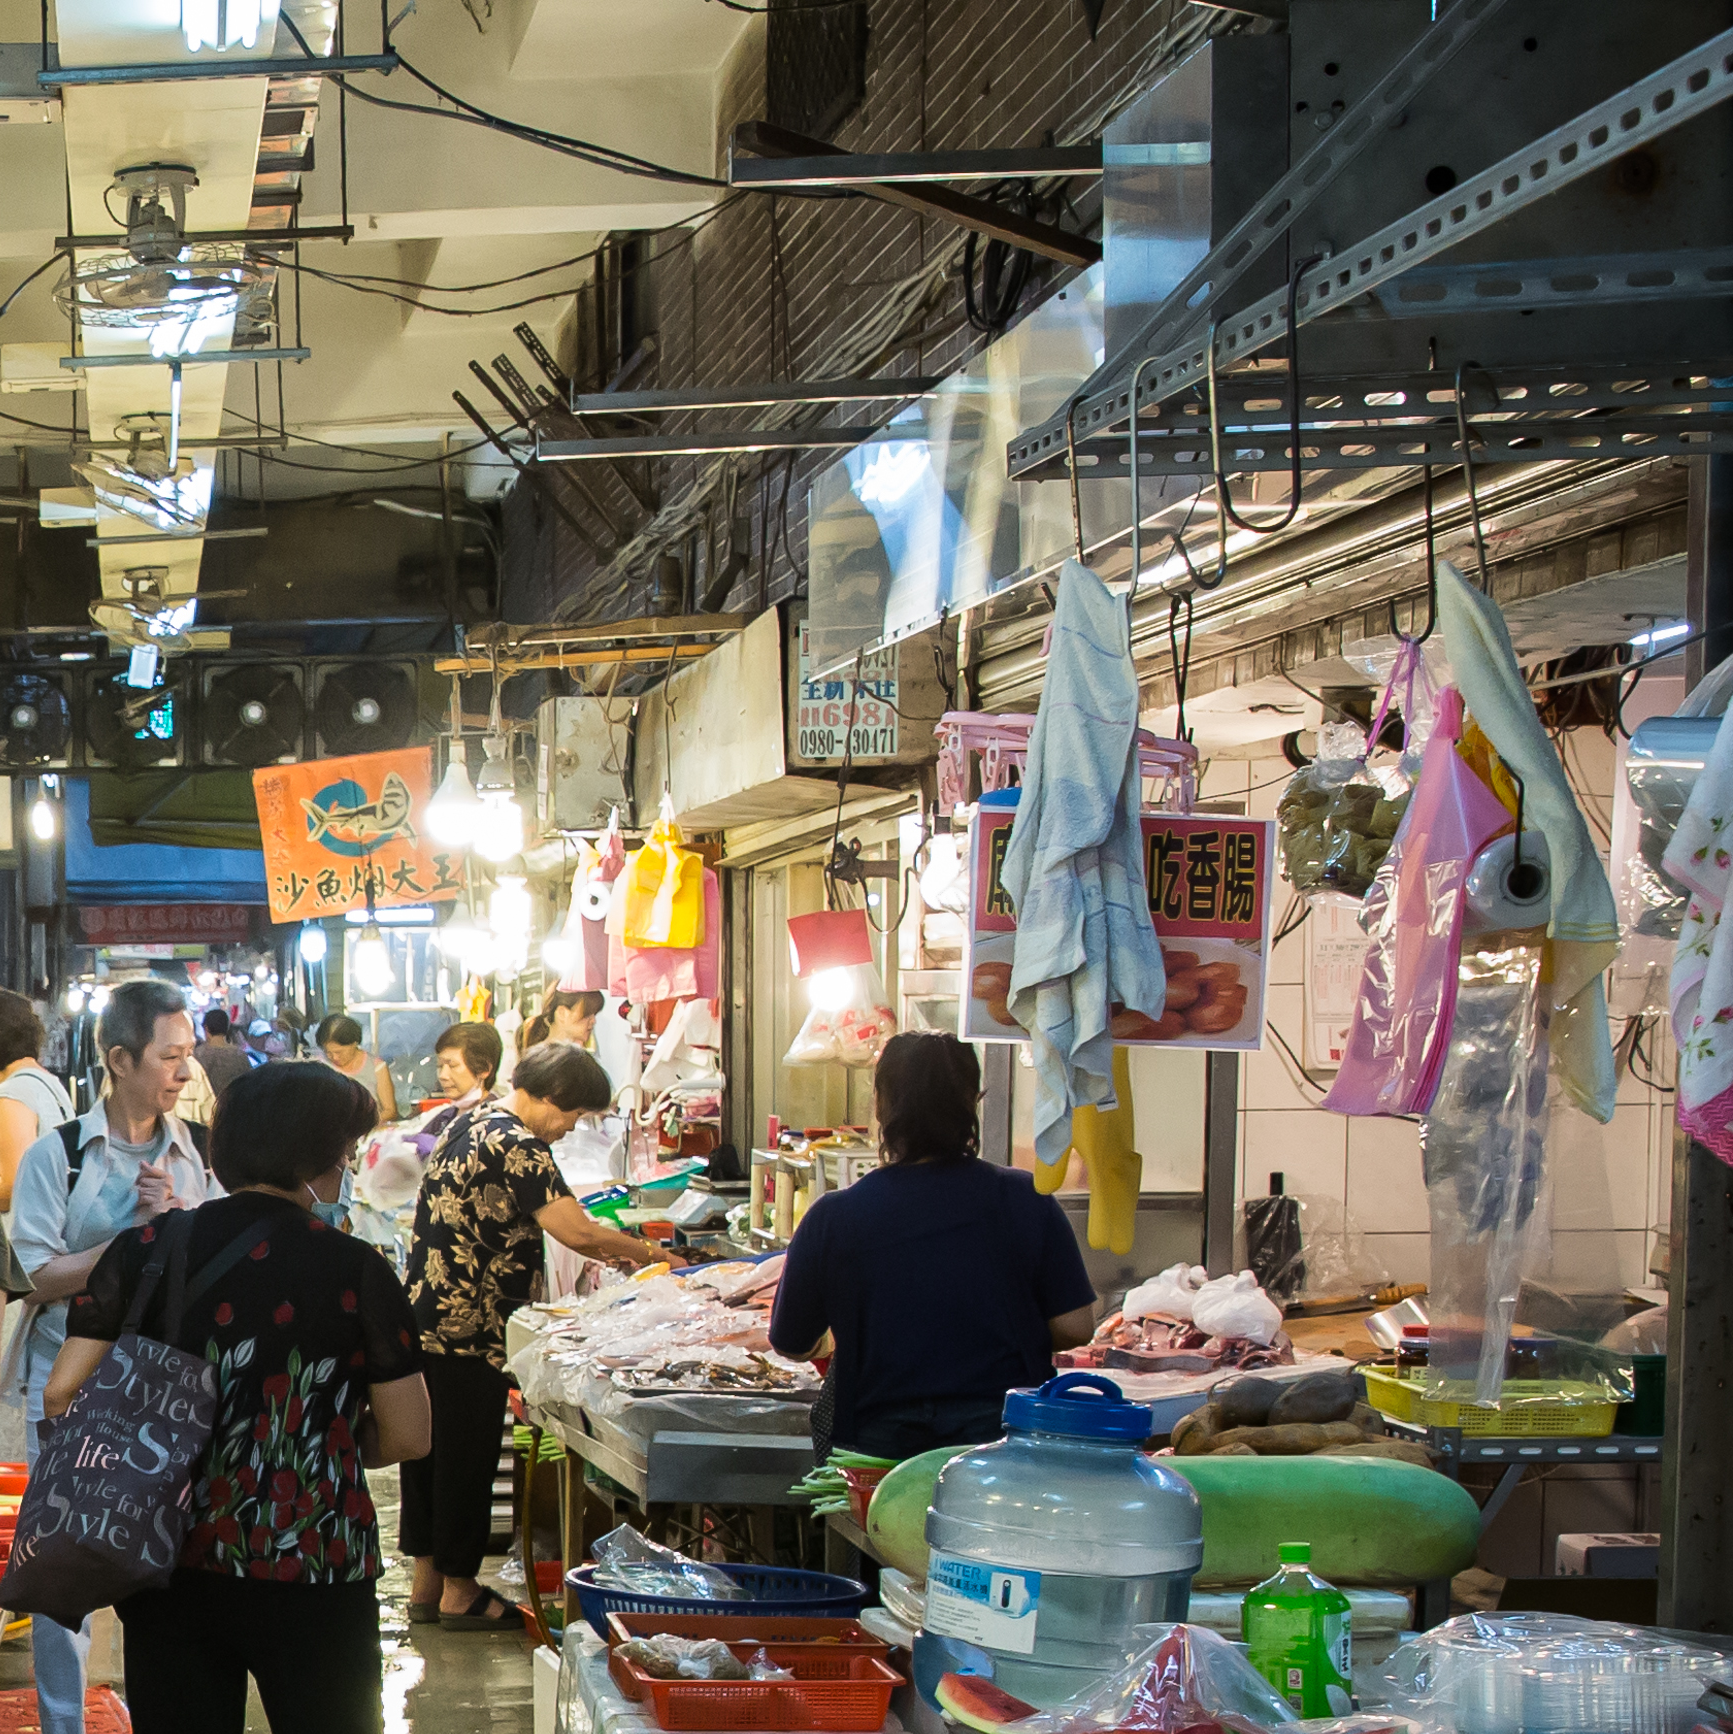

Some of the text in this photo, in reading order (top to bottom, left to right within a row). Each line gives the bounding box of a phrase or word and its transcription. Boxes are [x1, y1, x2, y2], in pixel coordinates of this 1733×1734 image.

[800, 729, 896, 755] 0980-30471
[1147, 828, 1256, 923] 吃香腸
[74, 1434, 120, 1471] life
[940, 1559, 982, 1580] WATER
